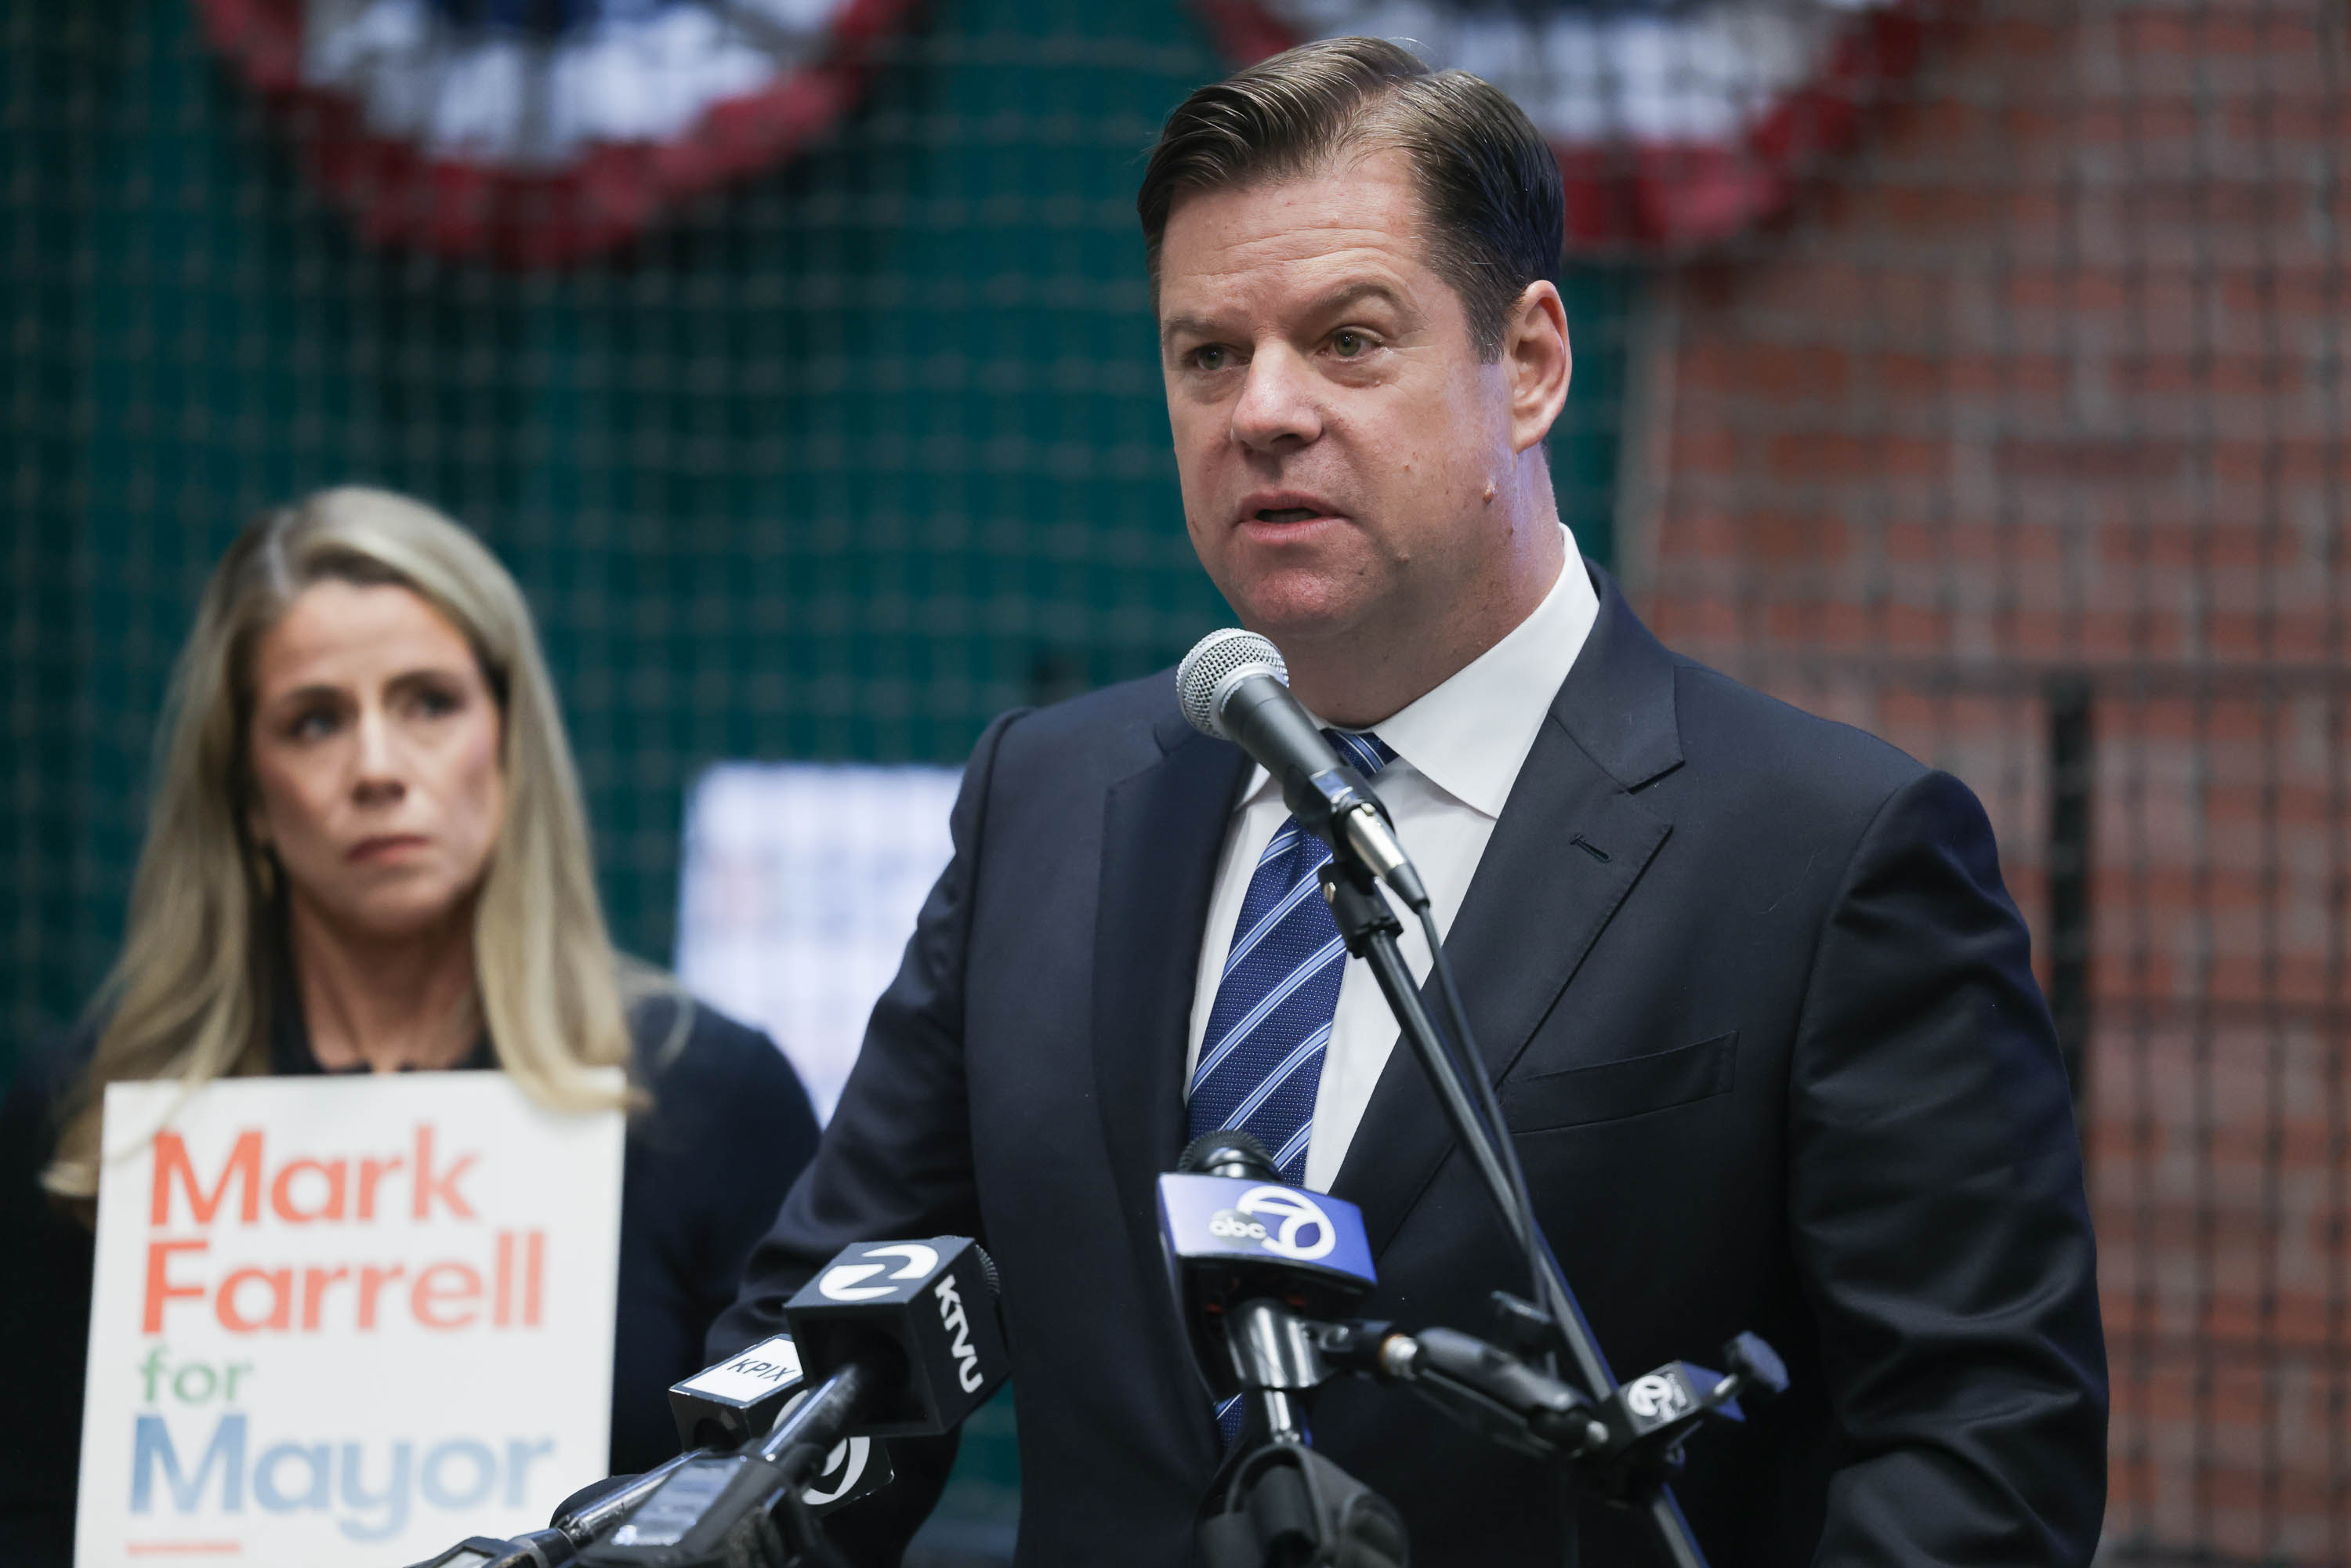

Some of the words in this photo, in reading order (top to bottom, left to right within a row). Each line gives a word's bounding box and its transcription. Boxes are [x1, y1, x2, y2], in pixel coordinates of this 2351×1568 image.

[150, 1121, 480, 1227] Mark
[1208, 1216, 1267, 1239] abc
[1237, 1186, 1335, 1260] 7
[141, 1230, 546, 1334] Farrell
[818, 1244, 939, 1301] 2
[726, 1358, 796, 1382] KPIX
[934, 1274, 984, 1394] KTVU
[139, 1345, 254, 1404] for
[127, 1412, 555, 1543] Mayor
